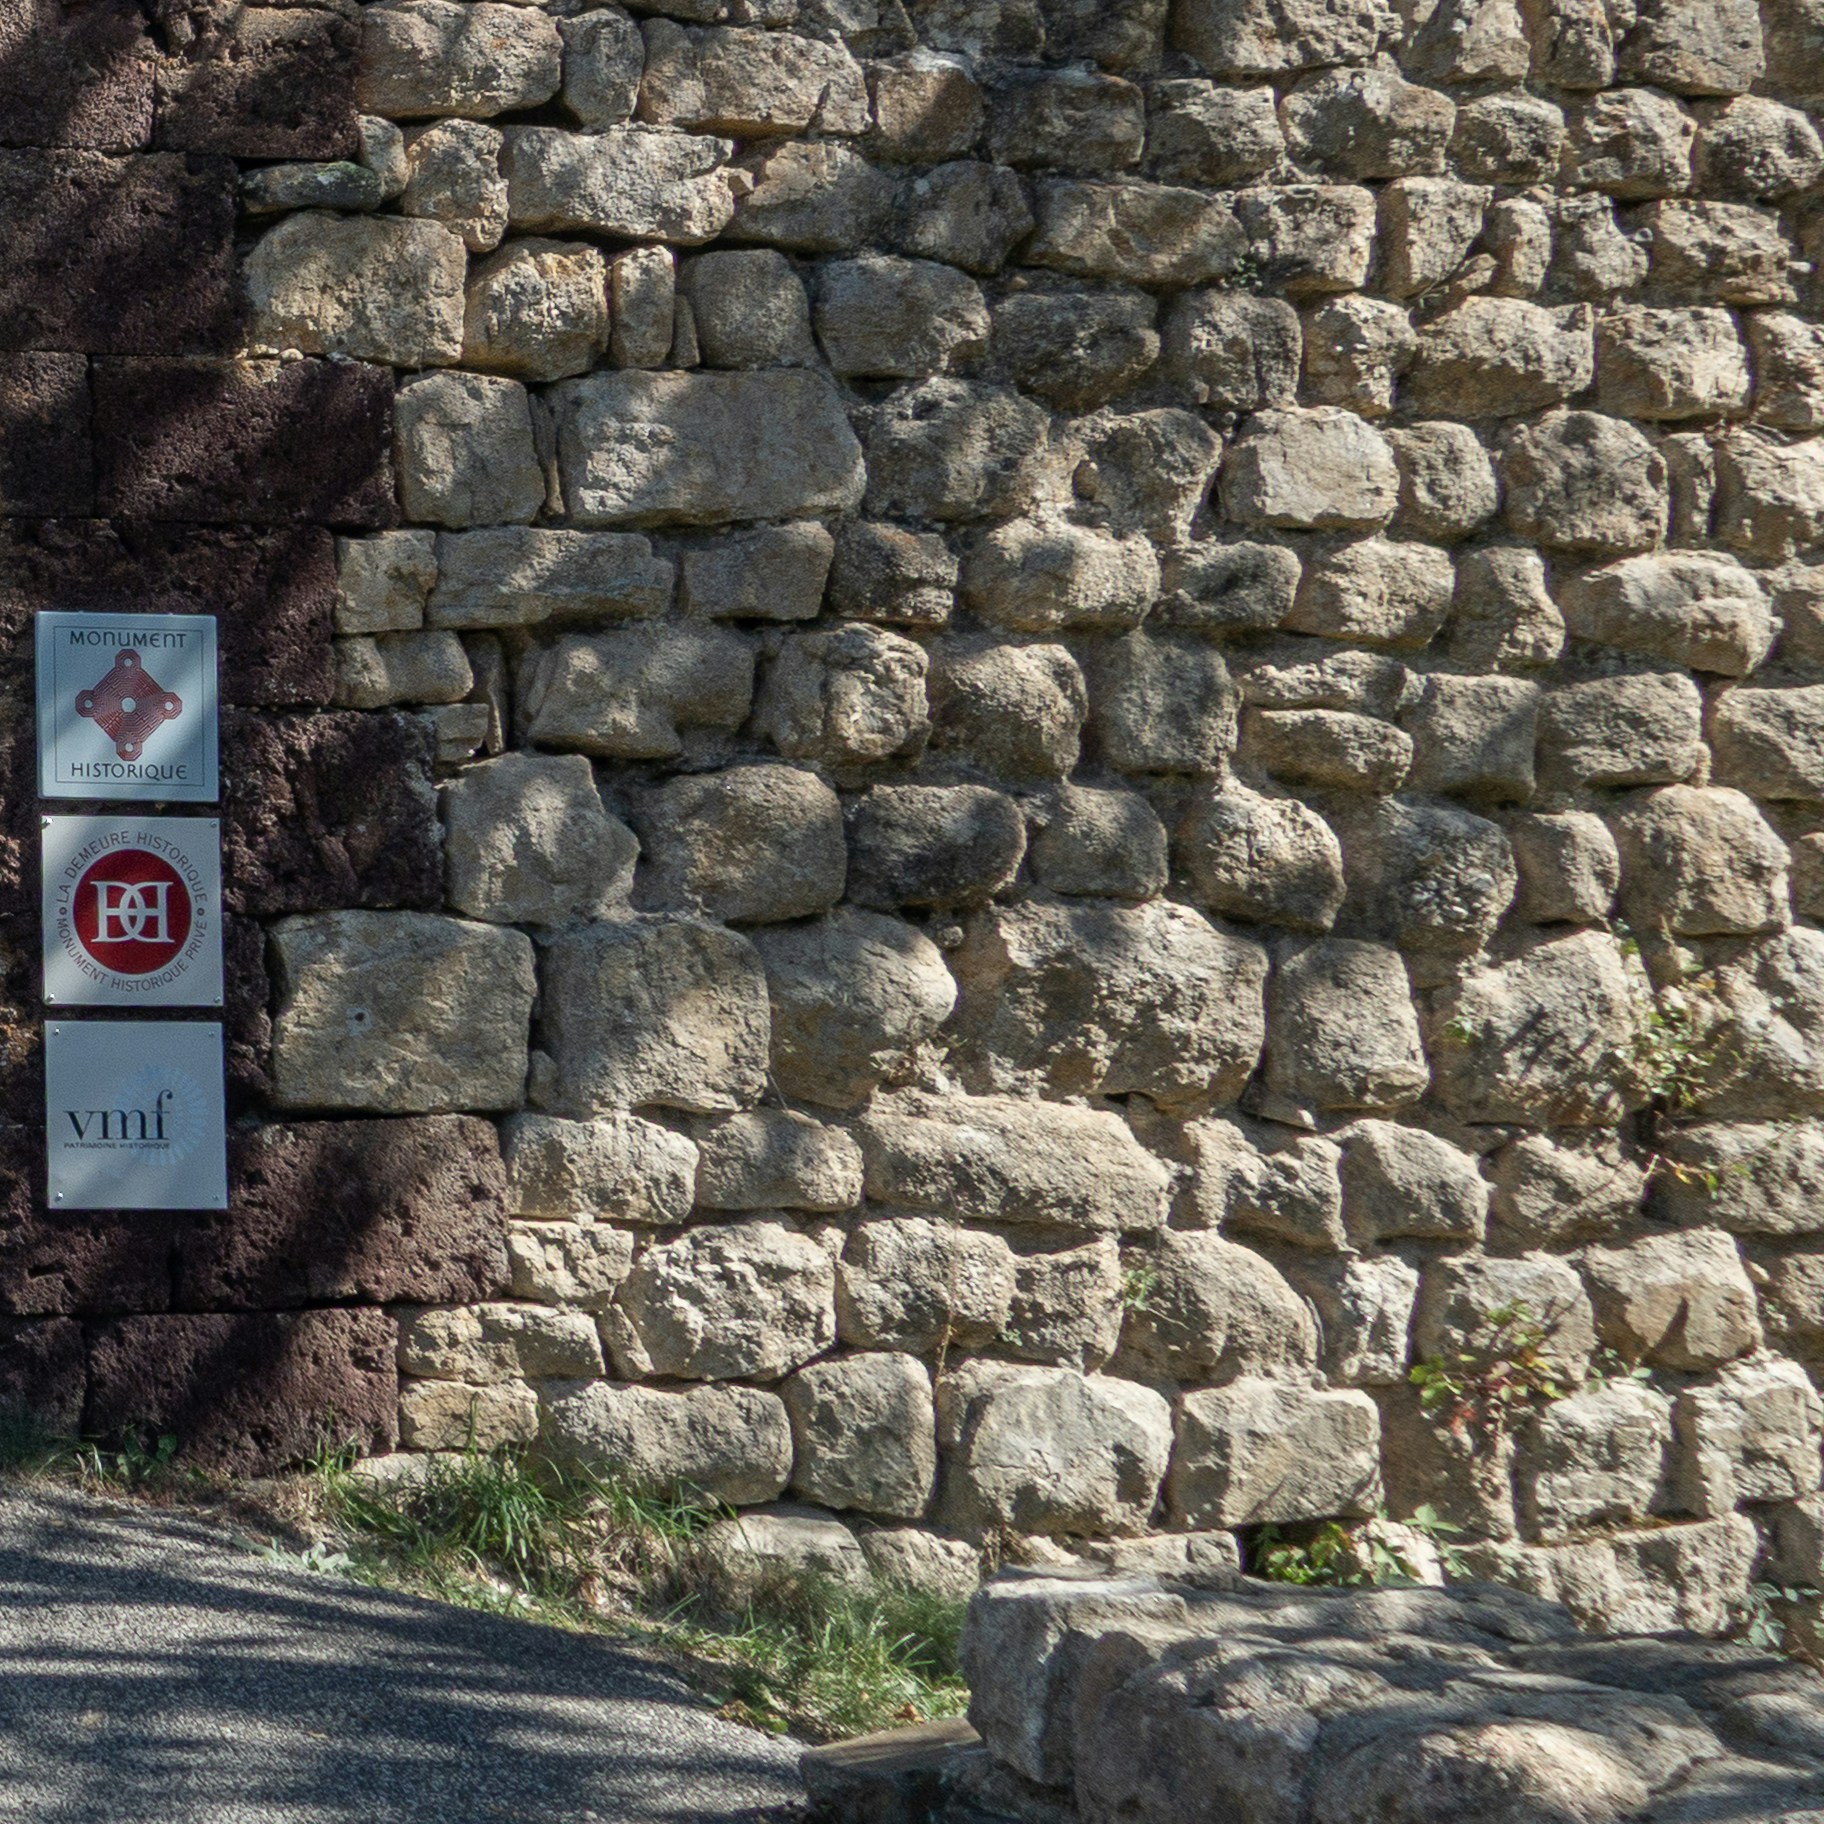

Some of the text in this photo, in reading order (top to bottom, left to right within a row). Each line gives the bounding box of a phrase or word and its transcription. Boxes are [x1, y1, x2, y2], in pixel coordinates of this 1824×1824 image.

[69, 630, 187, 648] MONUMENT
[71, 762, 187, 781] HISTORIQUE
[56, 830, 208, 903] LA DEMEURE HISTORIQUE
[57, 918, 208, 992] MONUMENT HISTORIQUE PRIVÉ
[63, 1089, 173, 1140] vmf
[119, 1142, 171, 1150] HISTORIQUE
